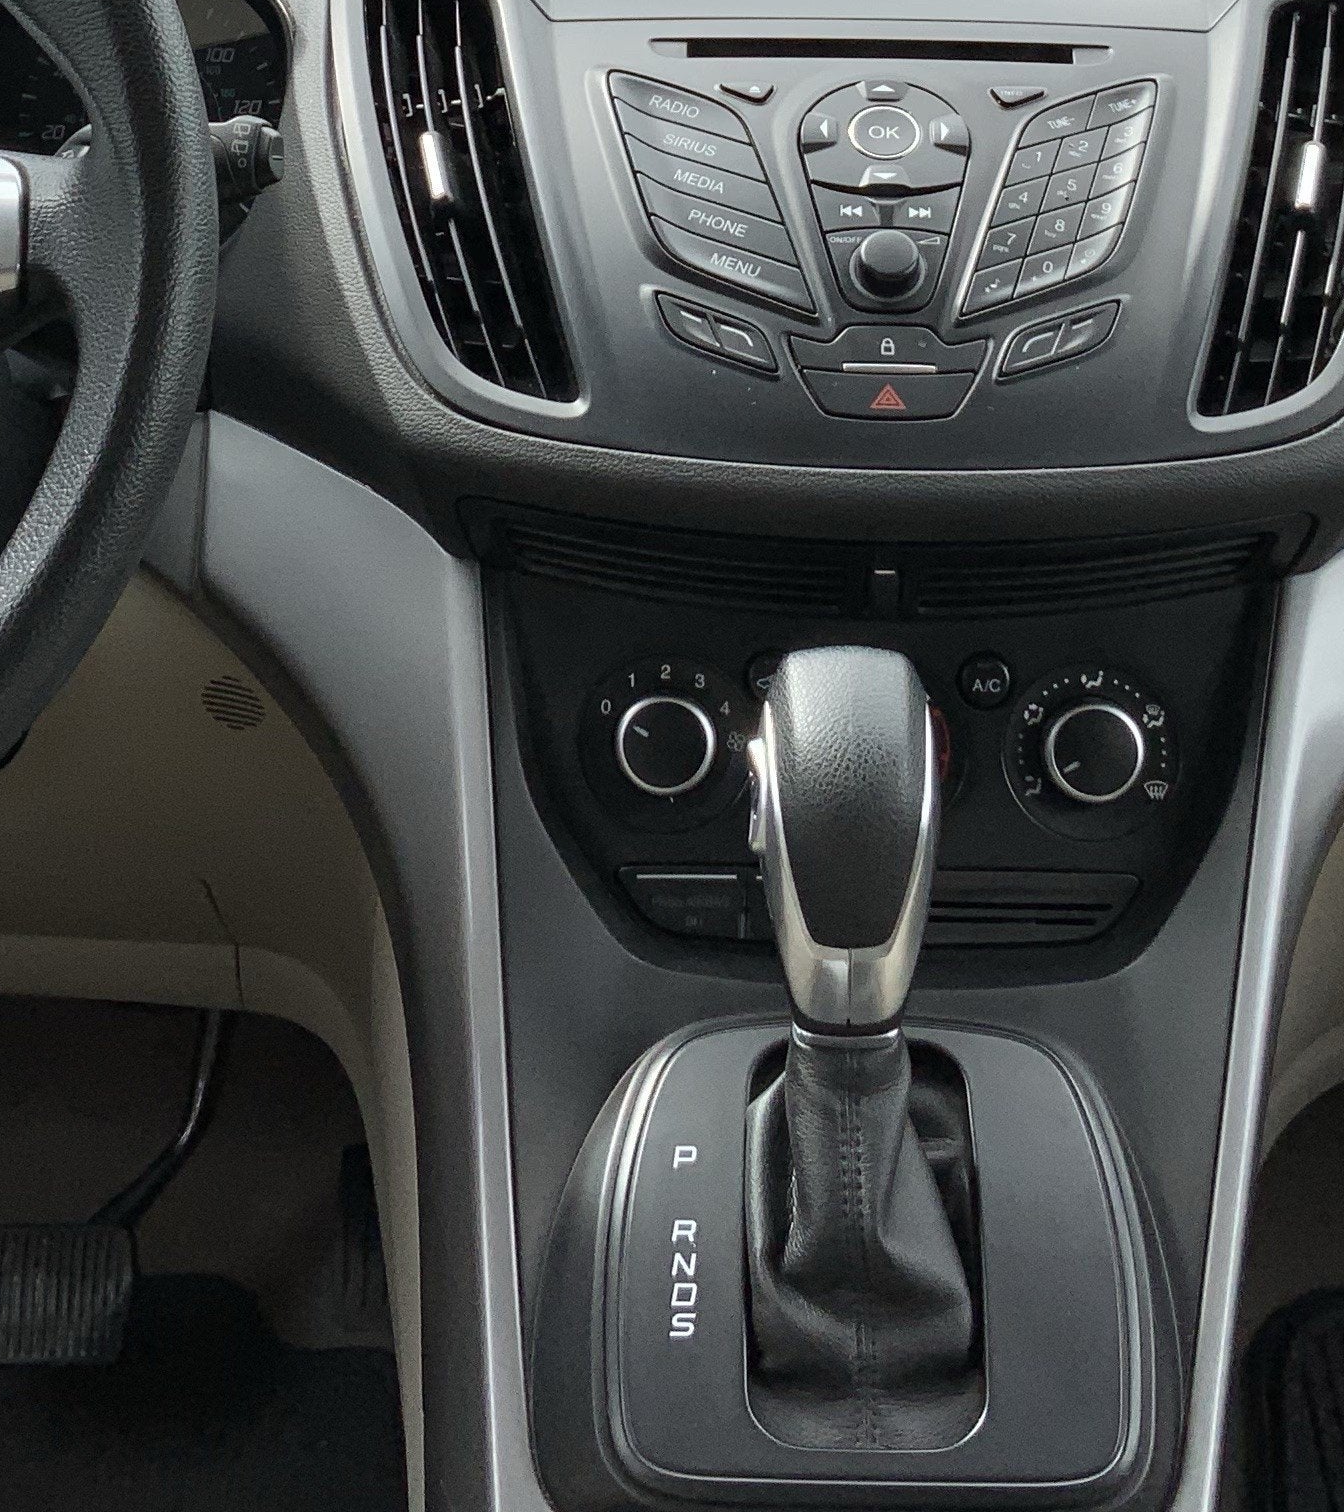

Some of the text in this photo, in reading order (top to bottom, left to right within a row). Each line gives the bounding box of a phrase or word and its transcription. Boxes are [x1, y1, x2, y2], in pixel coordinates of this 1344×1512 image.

[205, 47, 235, 63] 100
[233, 99, 263, 115] 120
[648, 95, 700, 119] RADIO
[868, 125, 900, 139] OK
[1123, 126, 1134, 137] 3
[663, 133, 717, 157] SIRIUS
[1078, 140, 1089, 152] 2
[1035, 151, 1042, 163] 1
[1113, 162, 1124, 174] 6
[673, 168, 725, 194] MEDIA
[1067, 178, 1077, 191] 5
[1018, 191, 1029, 203] 4
[1101, 202, 1112, 215] 9
[688, 209, 749, 238] PHONE
[1054, 219, 1066, 232] 8
[1006, 232, 1017, 245] 7
[710, 252, 762, 278] MENU
[1042, 260, 1054, 274] 0
[660, 664, 672, 679] 2
[628, 672, 635, 688] 1
[694, 673, 706, 688] 3
[972, 678, 1001, 693] A/C
[600, 698, 612, 715] 0
[719, 700, 731, 716] 4
[673, 1145, 698, 1169] P
[671, 1219, 698, 1243] R
[671, 1252, 697, 1277] N
[670, 1282, 698, 1307] D
[669, 1312, 697, 1338] S
